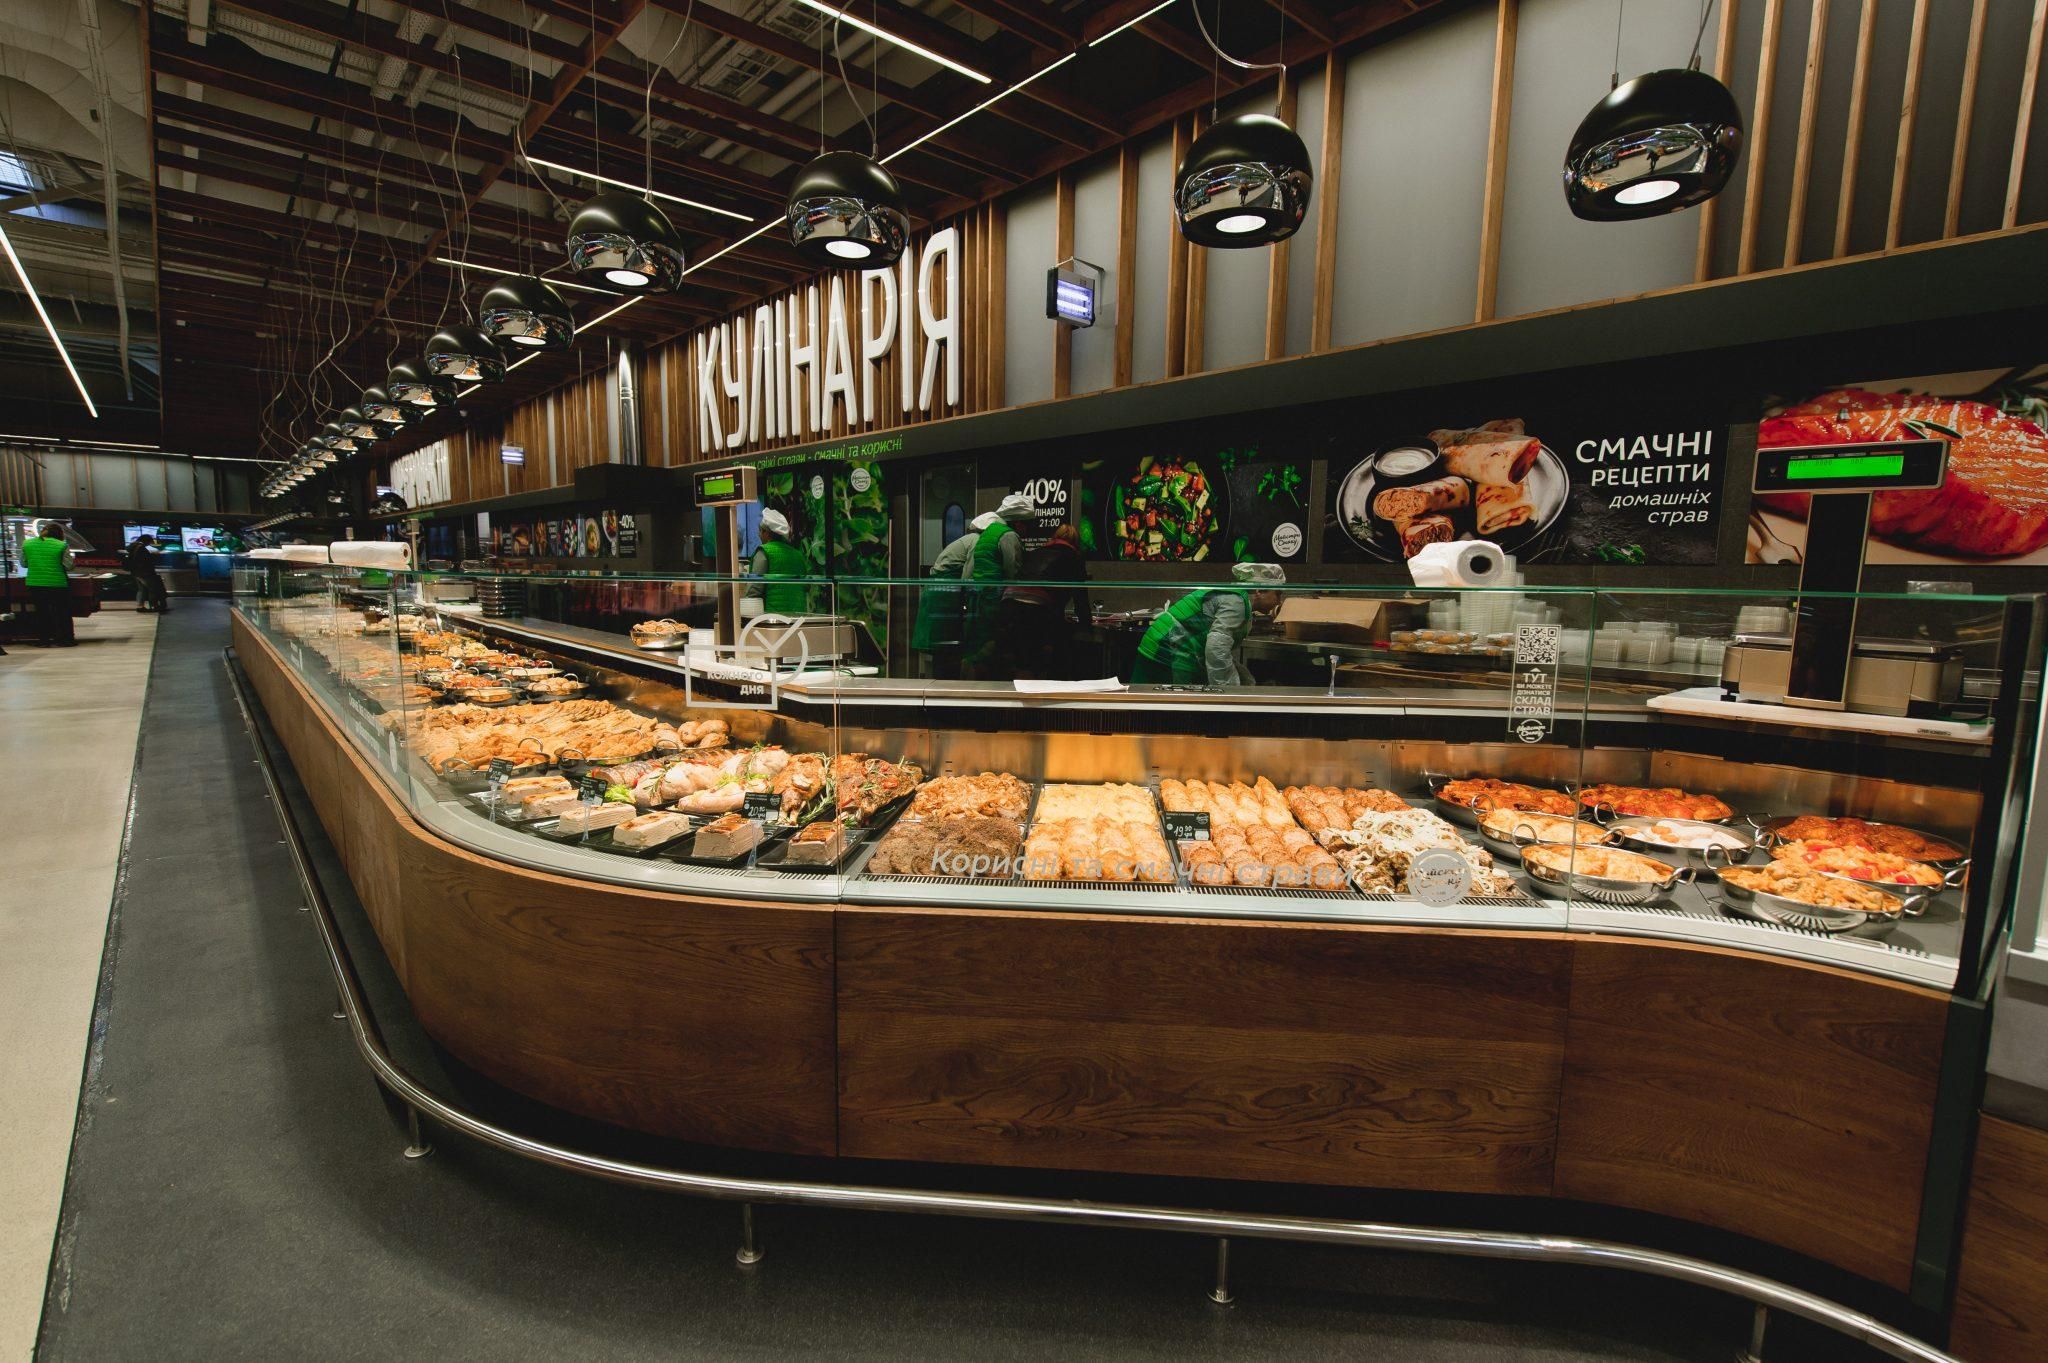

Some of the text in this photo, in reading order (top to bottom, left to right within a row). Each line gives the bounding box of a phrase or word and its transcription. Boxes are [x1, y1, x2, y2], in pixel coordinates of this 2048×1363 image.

[698, 226, 959, 453] КУЛІНАРІЯ
[814, 444, 845, 460] смачні
[847, 446, 859, 457] та
[861, 434, 903, 458] корисні
[1575, 430, 1712, 463] СМАЧНІ
[1591, 462, 1710, 488] РЕЦЕПТИ
[1608, 489, 1712, 509] домашніх
[1034, 507, 1066, 516] ЛІНАРІЮ
[1039, 518, 1061, 527] 21:00
[1647, 510, 1709, 527] страв
[707, 671, 764, 682] КОЖНОГО
[1522, 673, 1548, 683] ТУТ
[740, 685, 765, 696] ДНЯ
[1514, 696, 1552, 707] СКЛАД
[1513, 706, 1551, 716] СТРАВ
[1173, 825, 1184, 837] 19
[931, 847, 1352, 891] Корисні та смачні страви
